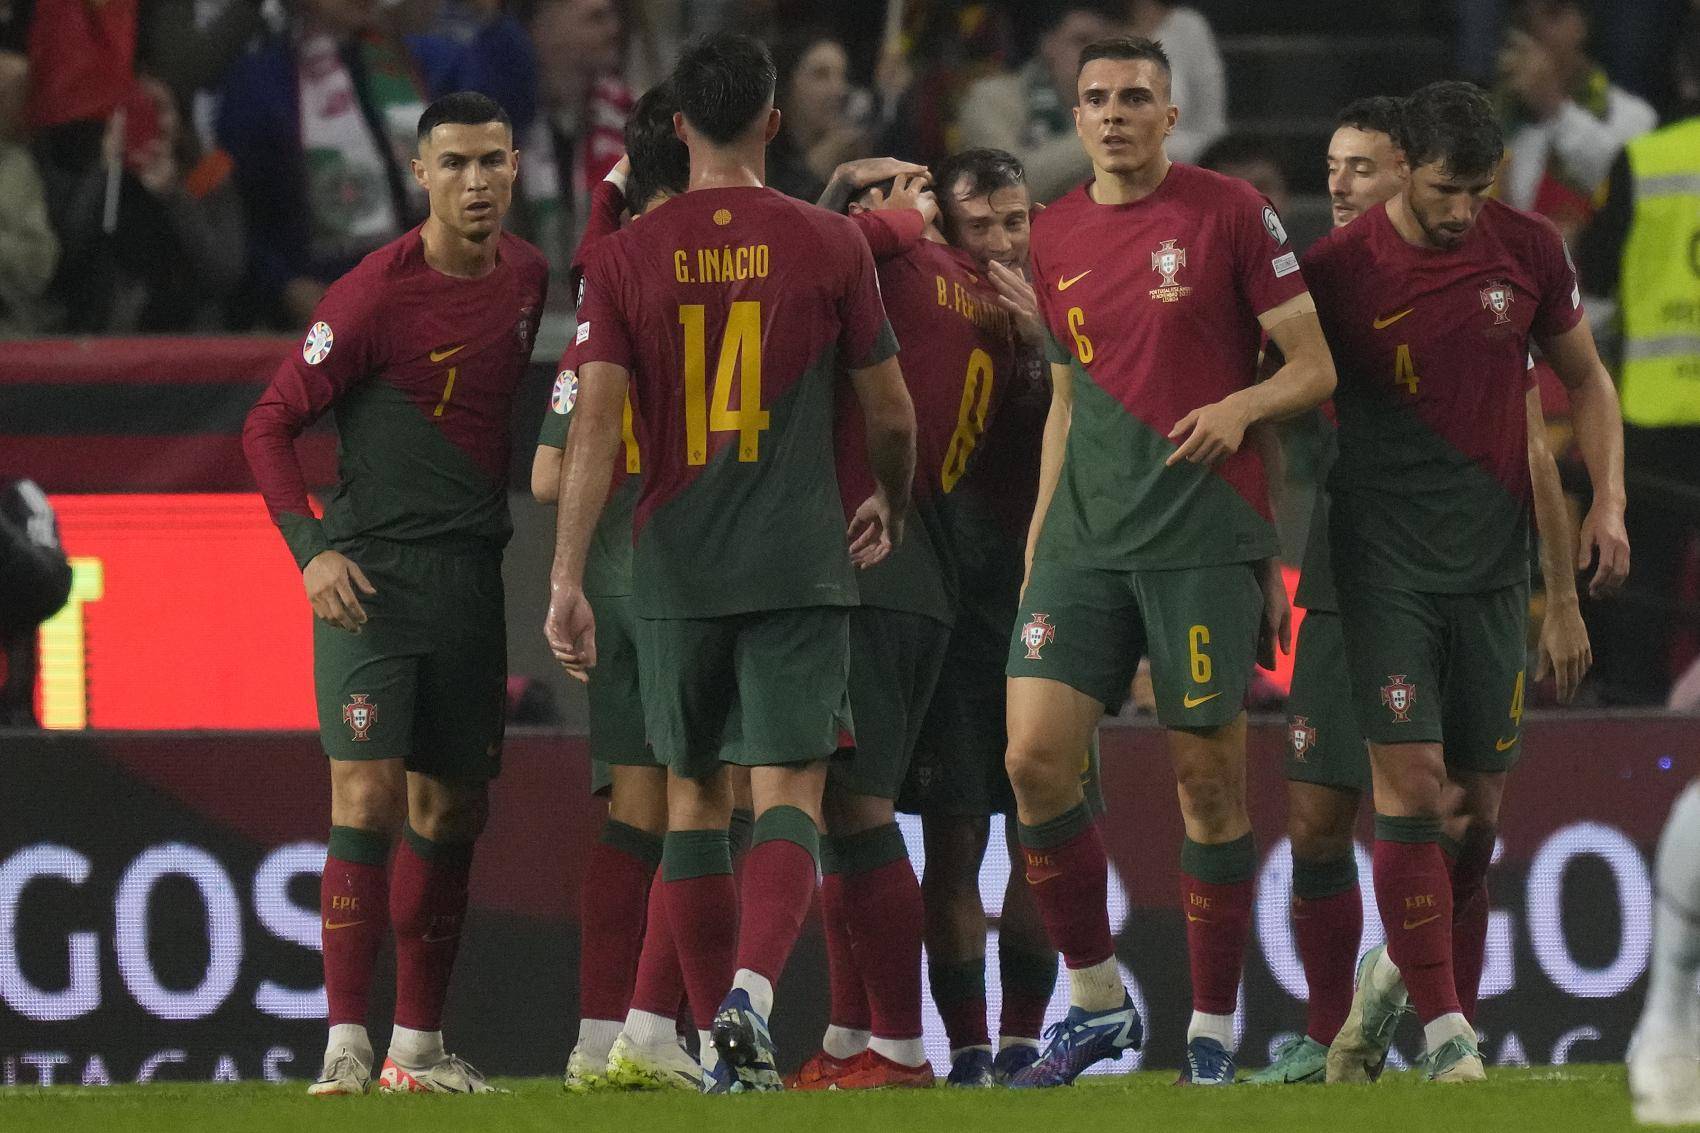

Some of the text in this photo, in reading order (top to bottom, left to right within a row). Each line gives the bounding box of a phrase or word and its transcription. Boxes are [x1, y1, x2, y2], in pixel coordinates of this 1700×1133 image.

[1067, 306, 1094, 364] 6
[679, 301, 770, 466] 14
[1394, 344, 1420, 394] 4
[1189, 624, 1212, 684] 6
